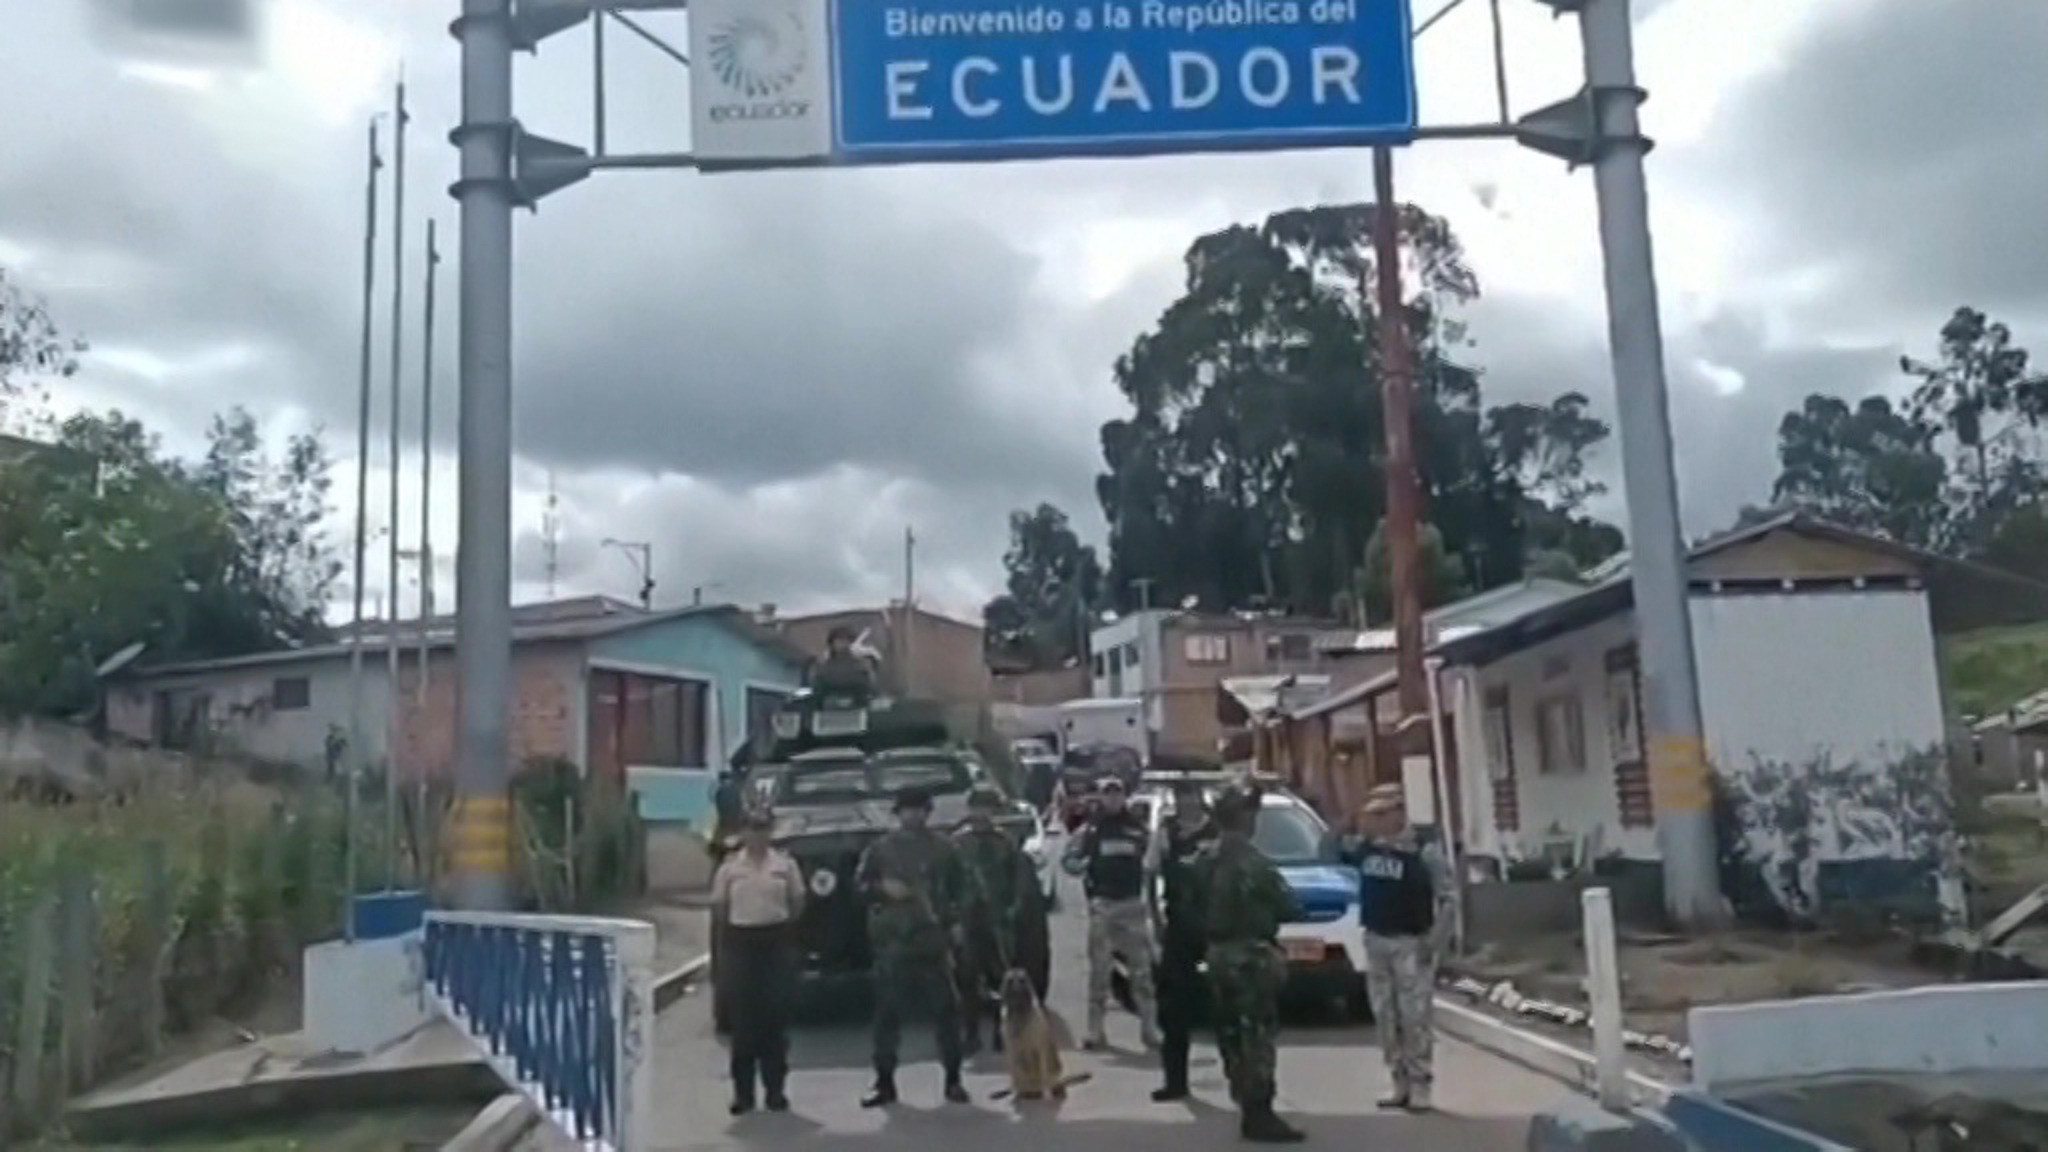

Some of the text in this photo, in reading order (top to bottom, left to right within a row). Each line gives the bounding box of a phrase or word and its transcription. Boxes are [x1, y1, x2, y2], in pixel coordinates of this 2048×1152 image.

[885, 0, 1356, 36] Bienvenido a la República del
[885, 46, 1360, 119] ECUADOR
